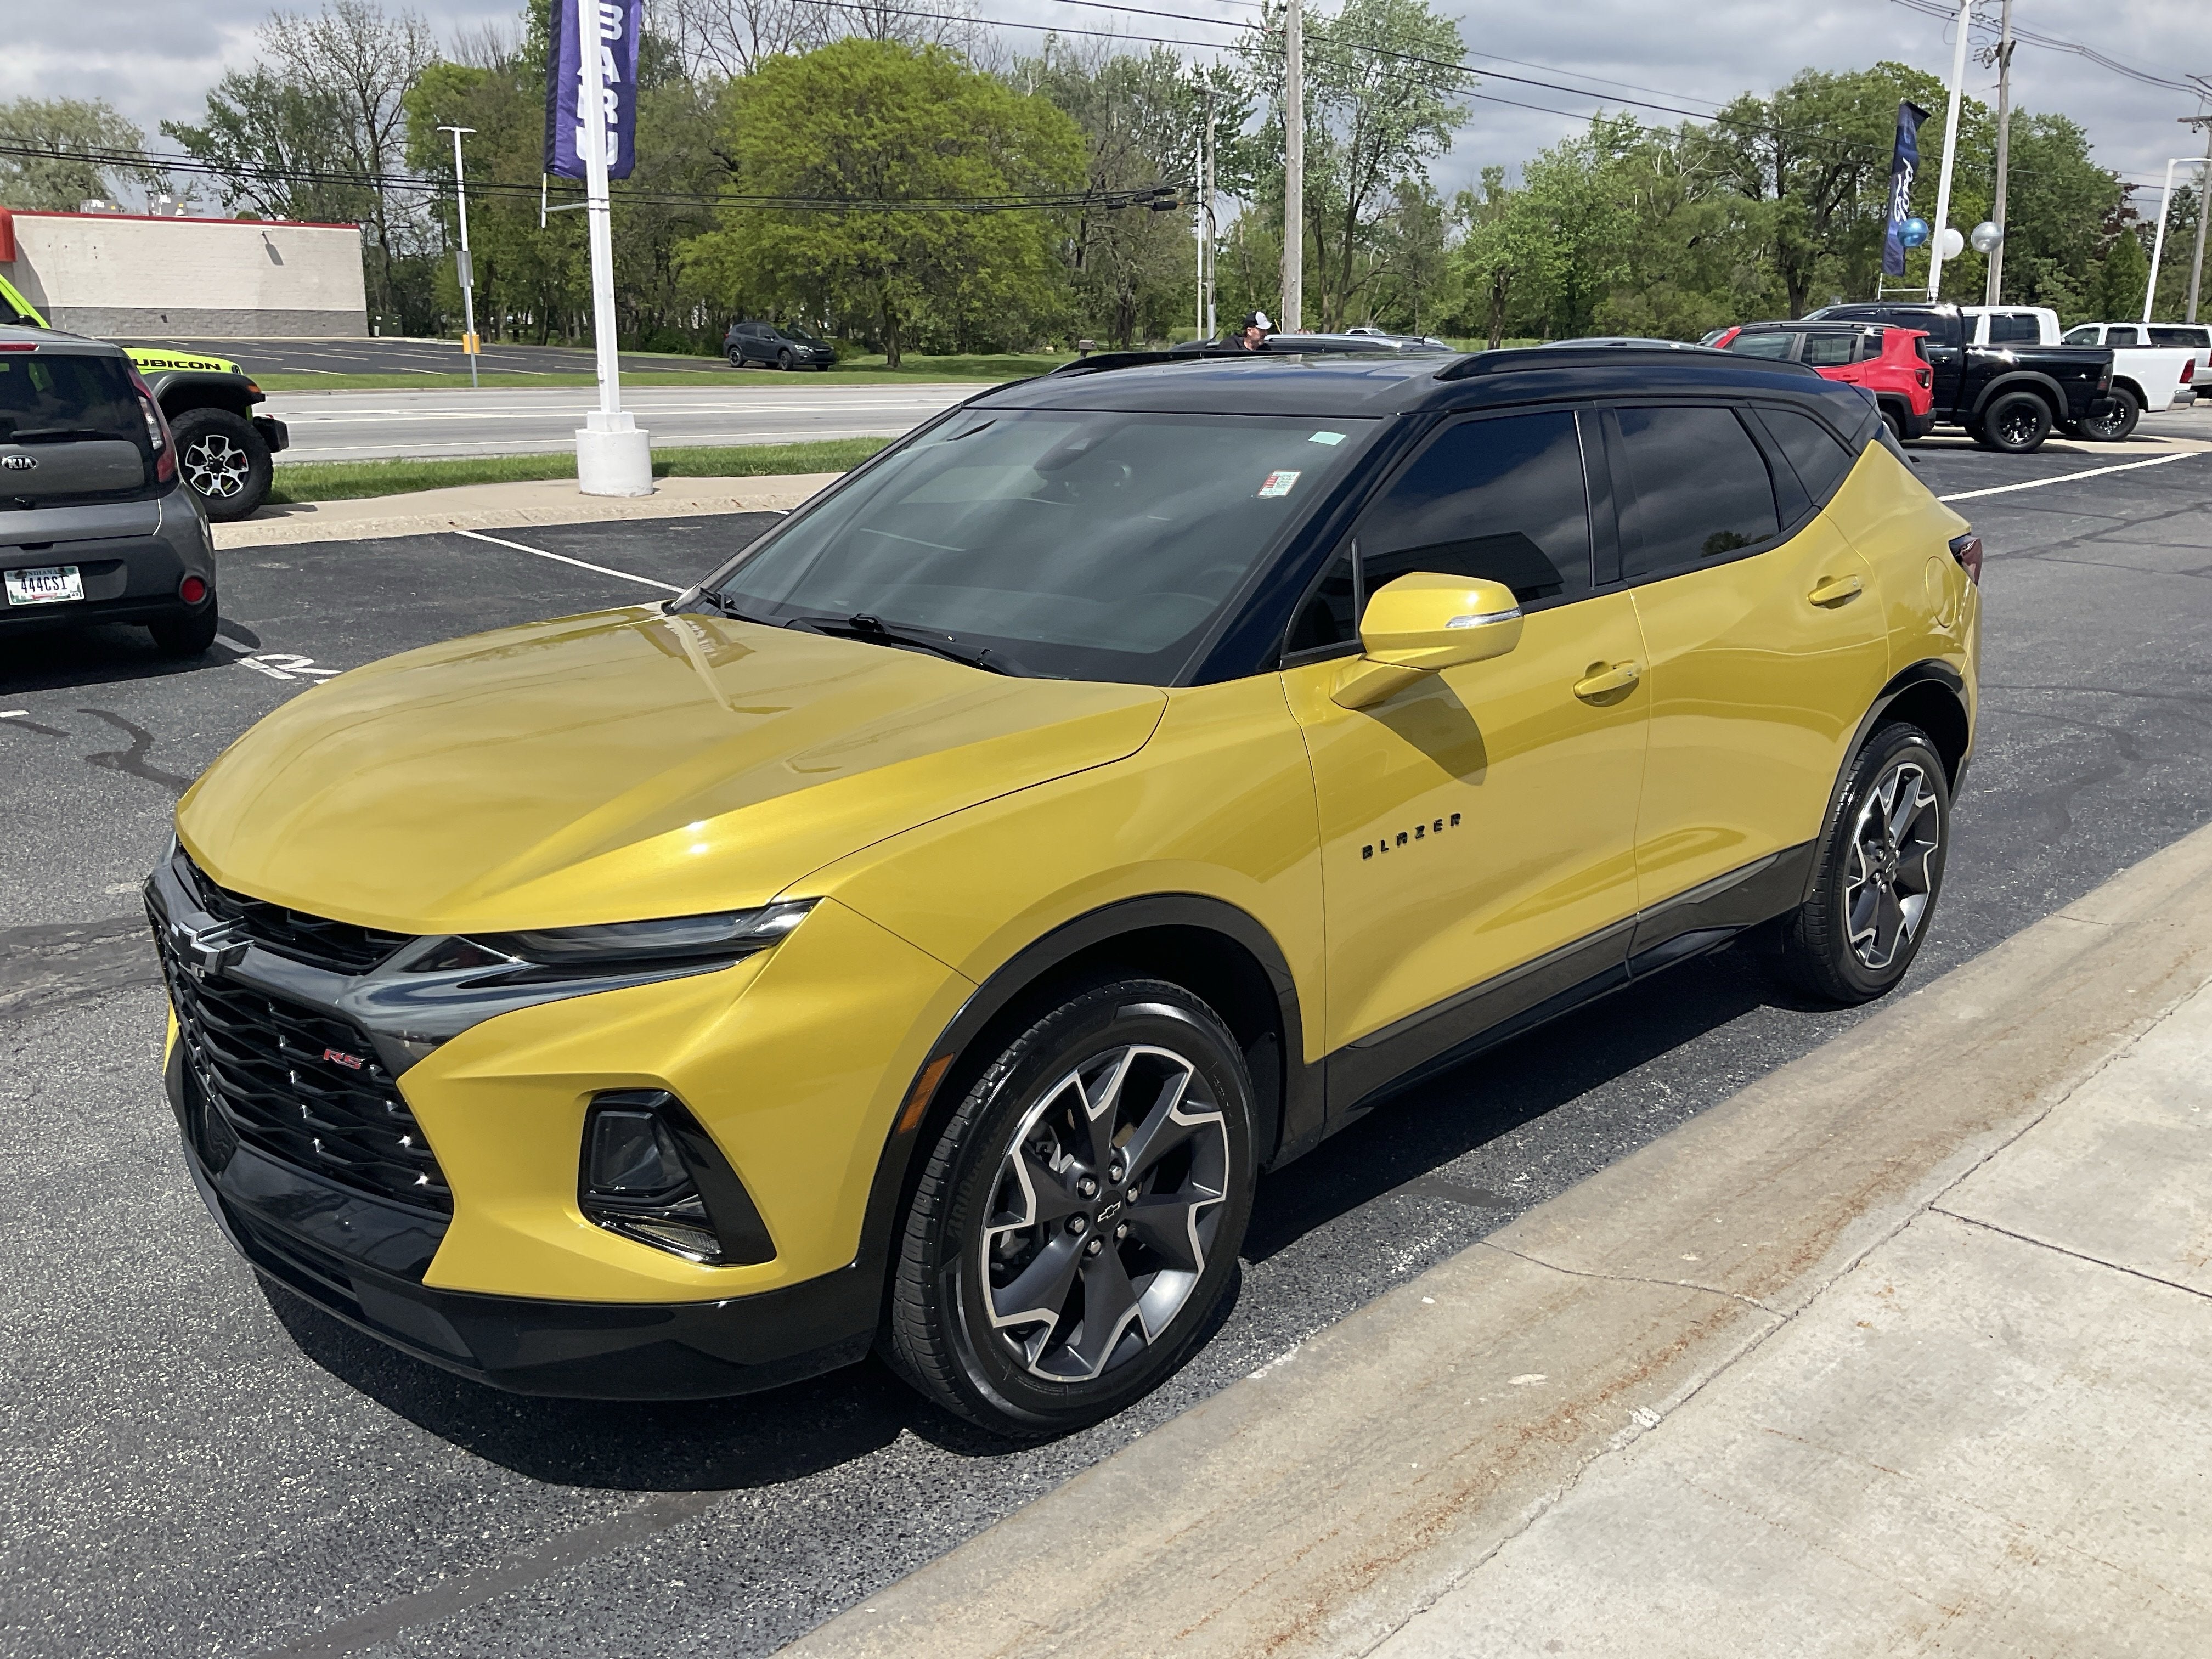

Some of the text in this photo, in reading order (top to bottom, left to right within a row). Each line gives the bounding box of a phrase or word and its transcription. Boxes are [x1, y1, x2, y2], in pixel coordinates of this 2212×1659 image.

[132, 358, 222, 370] UBICON
[8, 458, 33, 469] KIA
[1362, 813, 1461, 860] BLAZER
[323, 1048, 364, 1069] RS
